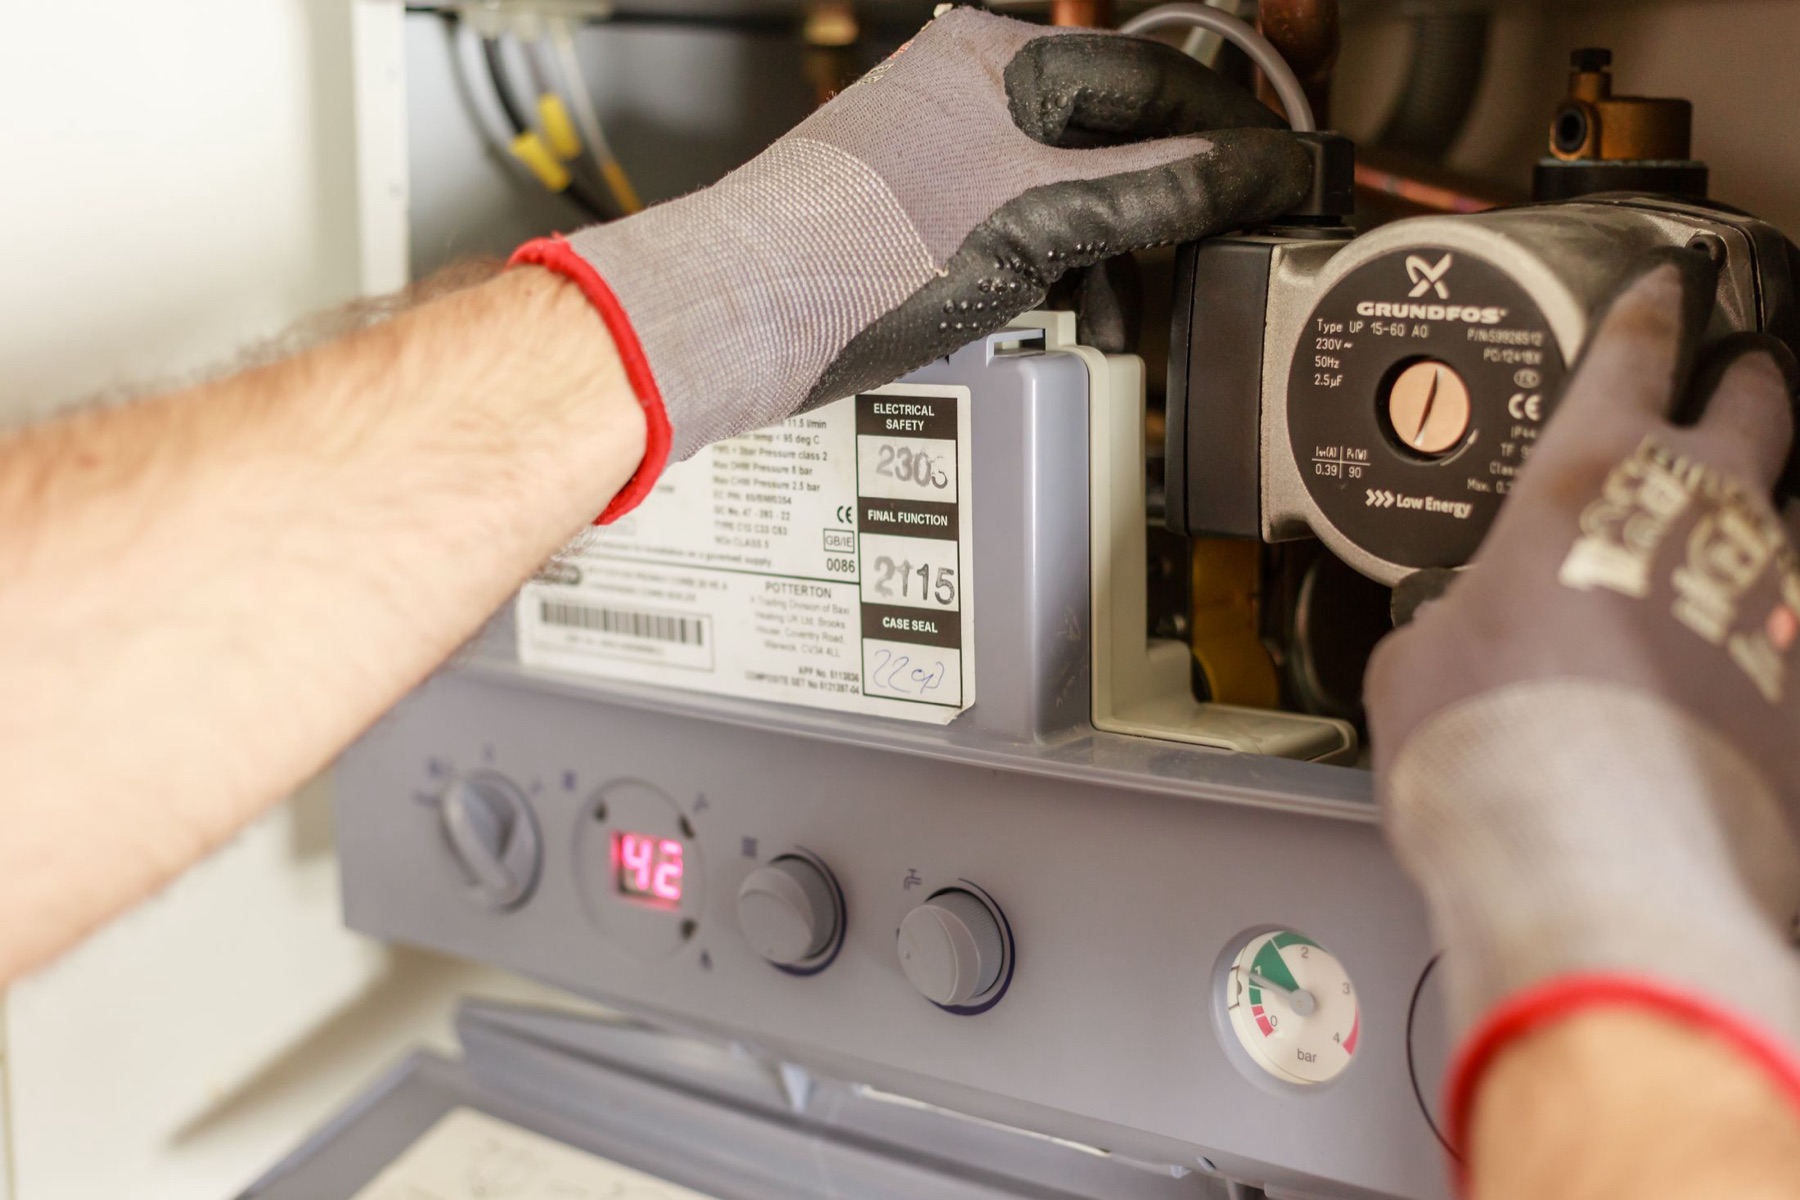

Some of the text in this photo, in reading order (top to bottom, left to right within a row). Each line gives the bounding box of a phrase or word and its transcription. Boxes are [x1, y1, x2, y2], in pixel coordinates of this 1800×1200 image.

[1356, 301, 1503, 325] GRUNDFOS
[1316, 318, 1343, 334] Type
[1349, 320, 1363, 334] UP
[1370, 321, 1405, 337] 15-60
[1314, 355, 1340, 369] 50Hz
[873, 402, 935, 417] ELECTRICAL
[885, 418, 924, 431] SAFETY
[759, 447, 796, 459] Pressure
[798, 450, 820, 461] class
[822, 451, 828, 461] 2
[753, 462, 789, 474] Pressure
[799, 464, 813, 475] bar
[1315, 463, 1361, 479] 0.39 90
[753, 478, 789, 490] Pressure
[792, 480, 804, 491] 2.5
[806, 482, 820, 493] bar
[1396, 493, 1473, 519] Low Energy
[836, 505, 853, 524] CE
[867, 509, 948, 526] FINAL FUNCTION
[825, 535, 853, 548] GB/IE
[826, 557, 856, 573] 0086
[873, 555, 956, 606] 2115
[765, 581, 832, 599] POTTERTON
[822, 602, 831, 612] of
[832, 604, 850, 615] Baxi
[818, 617, 846, 629] Brooks
[882, 616, 938, 634] CASE SEAL
[622, 833, 683, 901] 42
[1300, 946, 1309, 959] 2
[1254, 965, 1262, 976] 1
[1342, 982, 1350, 995] 3
[1270, 1014, 1278, 1027] 0
[1332, 1032, 1340, 1044] 4
[1296, 1047, 1317, 1063] bar
